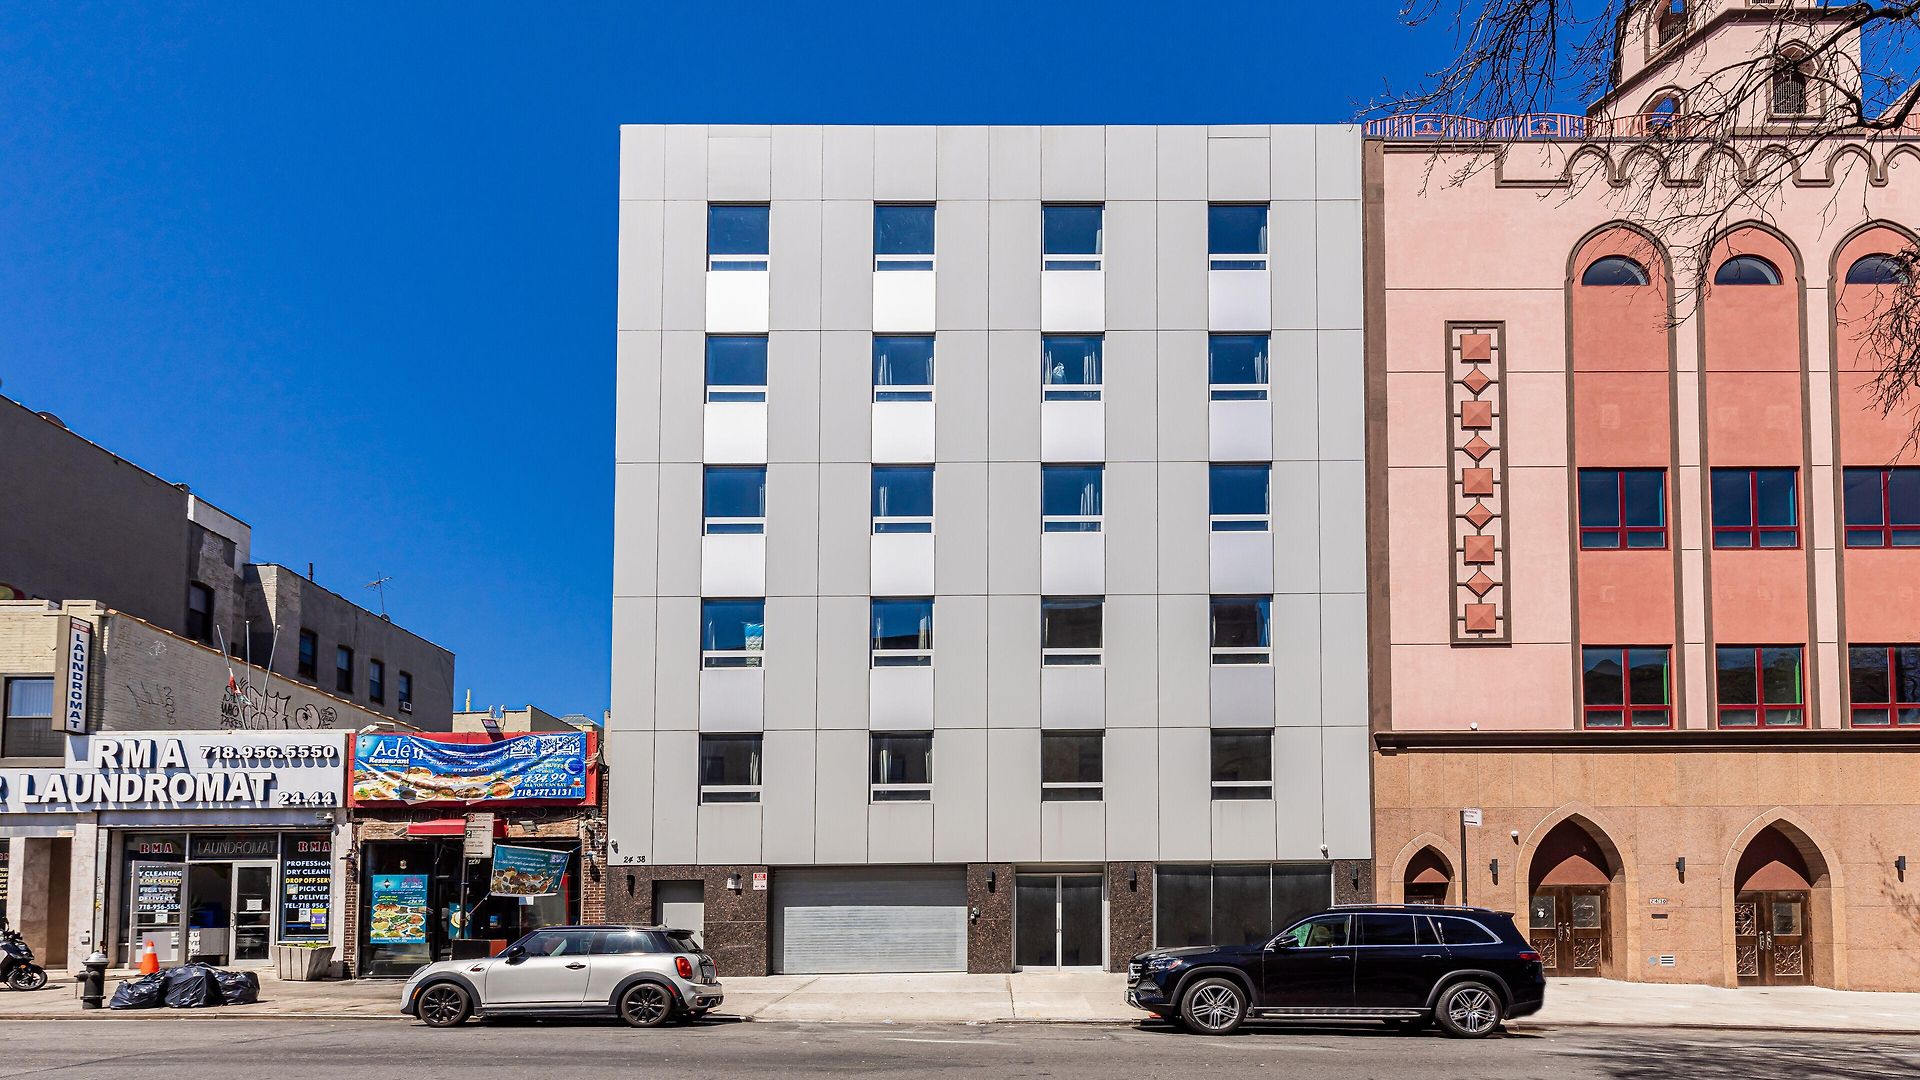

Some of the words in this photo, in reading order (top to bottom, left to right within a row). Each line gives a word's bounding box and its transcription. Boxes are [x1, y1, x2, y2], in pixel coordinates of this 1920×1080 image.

[70, 634, 84, 729] LAUNDROMAT
[93, 738, 186, 769] RMA
[200, 745, 335, 759] 718.956.5550
[373, 738, 424, 760] Aden
[19, 773, 273, 803] LAUNDROMAT
[516, 788, 572, 797] 718.777.3131
[140, 842, 173, 853] RMA
[198, 841, 275, 854] LAUNDROMAT
[297, 841, 331, 852] RMA
[636, 855, 646, 863] 38
